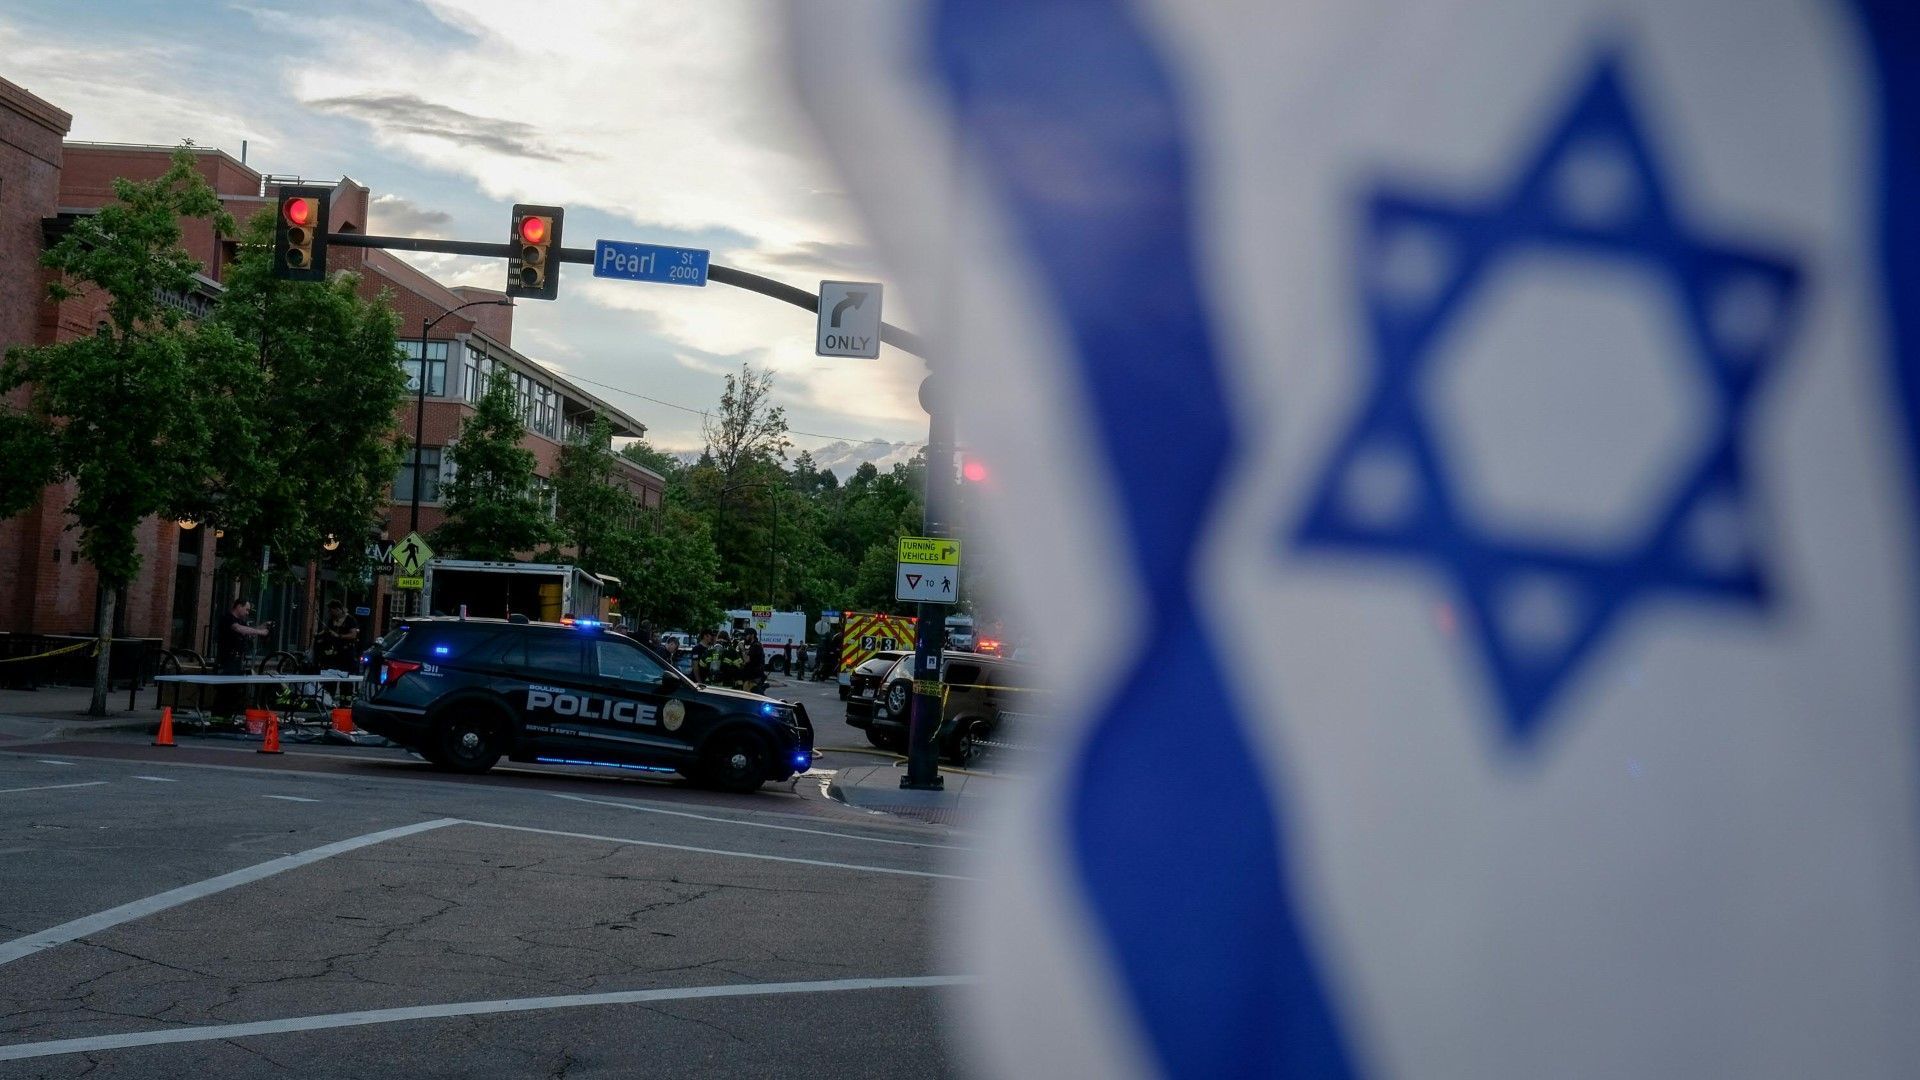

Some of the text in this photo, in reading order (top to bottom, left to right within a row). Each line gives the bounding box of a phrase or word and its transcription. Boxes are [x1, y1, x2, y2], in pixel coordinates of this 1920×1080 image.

[602, 247, 693, 274] Pearl St
[669, 265, 699, 281] 2000
[825, 334, 871, 351] ONLY
[903, 541, 936, 551] TURNING
[902, 552, 939, 561] VEHICLES
[402, 578, 420, 586] AHEAD
[925, 579, 935, 588] TO
[865, 637, 892, 651] 2 3
[423, 664, 439, 673] 911
[528, 684, 566, 694] BOULDER
[526, 690, 658, 726] POLICE
[525, 723, 549, 732] SERVICE
[555, 728, 577, 736] SAFETY
